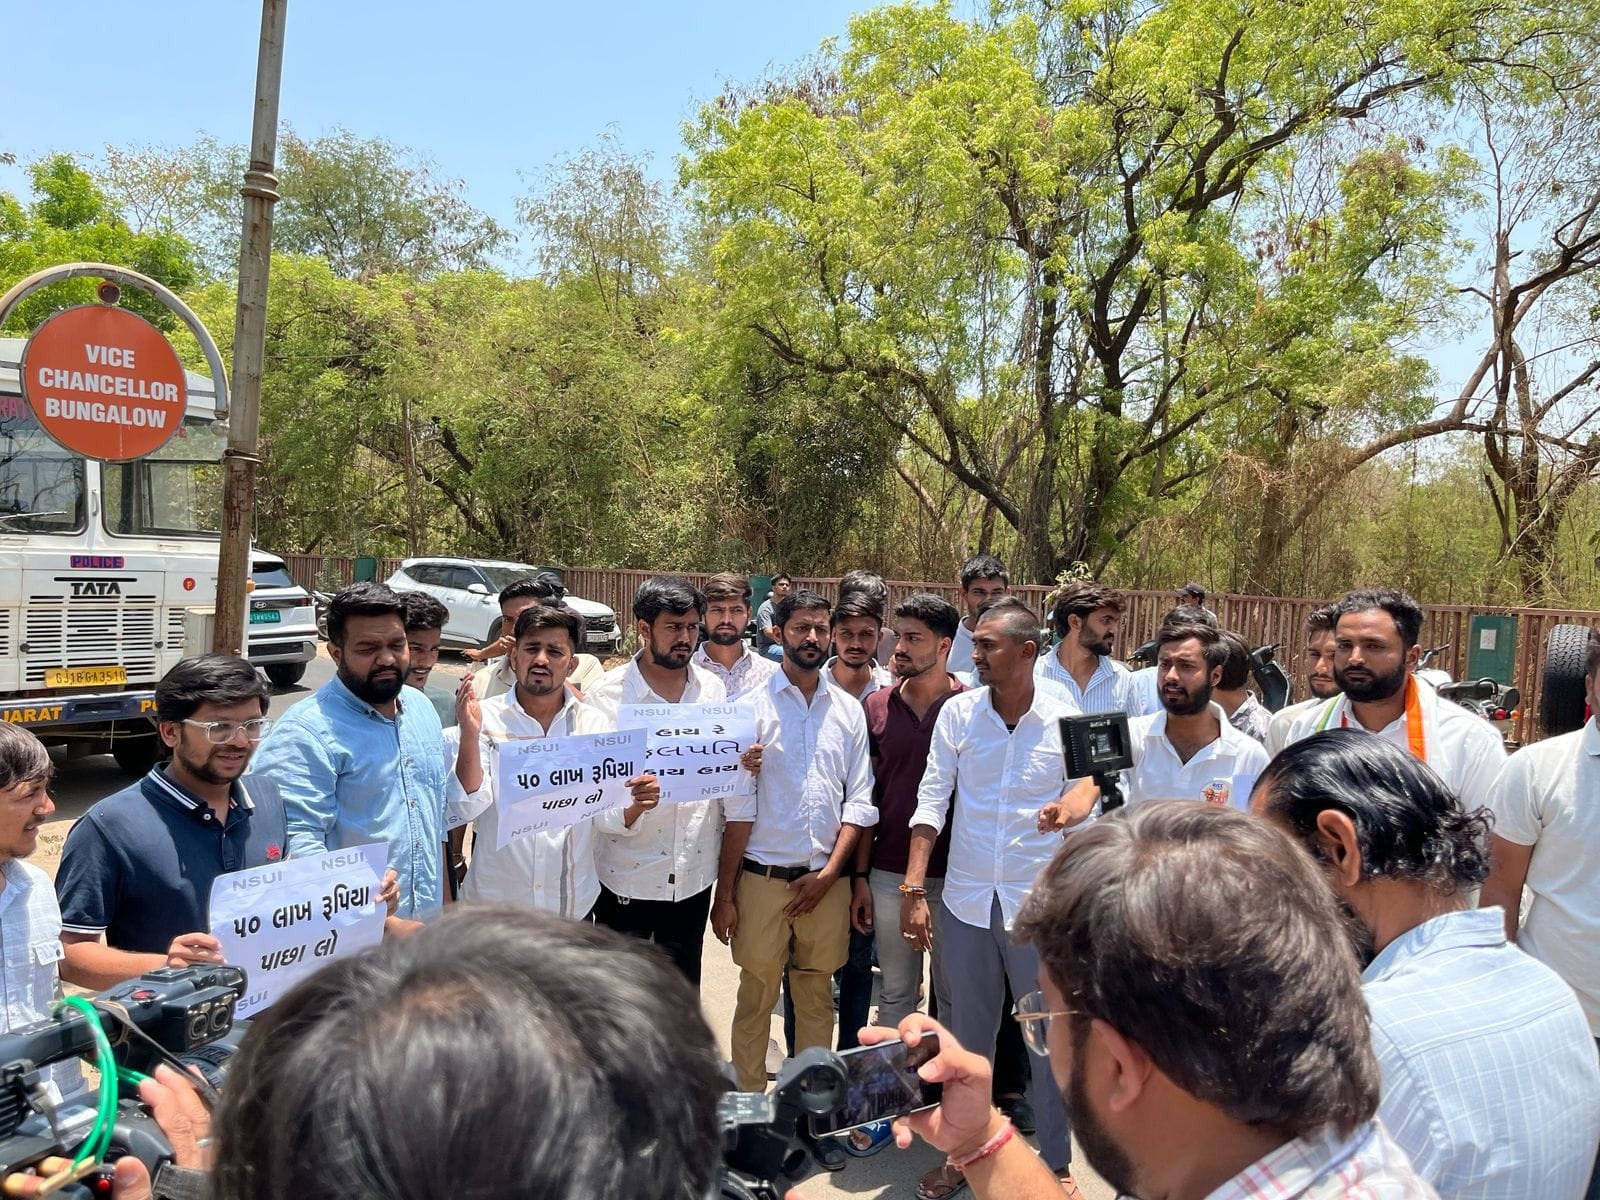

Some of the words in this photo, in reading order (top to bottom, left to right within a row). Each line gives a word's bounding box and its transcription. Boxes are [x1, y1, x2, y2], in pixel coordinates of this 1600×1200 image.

[85, 344, 135, 369] VICE
[39, 367, 179, 402] CHANCELLOR
[45, 398, 167, 428] BUNGALOW
[72, 556, 123, 568] POLICE
[71, 582, 121, 596] TATA
[633, 708, 671, 716] NSUI
[702, 706, 737, 715] NSUI
[518, 743, 559, 755] NSUI
[594, 735, 631, 747] NSUI
[517, 774, 540, 789] ૫૦
[549, 768, 583, 786] લાખ
[592, 758, 633, 784] રૂપિયા
[542, 797, 578, 810] પાછા
[585, 789, 603, 804] લો
[701, 784, 735, 795] NSUI
[511, 820, 549, 838] NSUI
[232, 870, 283, 891] NSUI
[321, 852, 366, 872] NSUI
[233, 915, 261, 938] ૫૦
[272, 900, 312, 928] લાખ
[322, 883, 369, 921] રૂપિયા
[261, 944, 306, 971] પાછા
[314, 929, 338, 957] લો
[237, 990, 268, 1011] SUI
